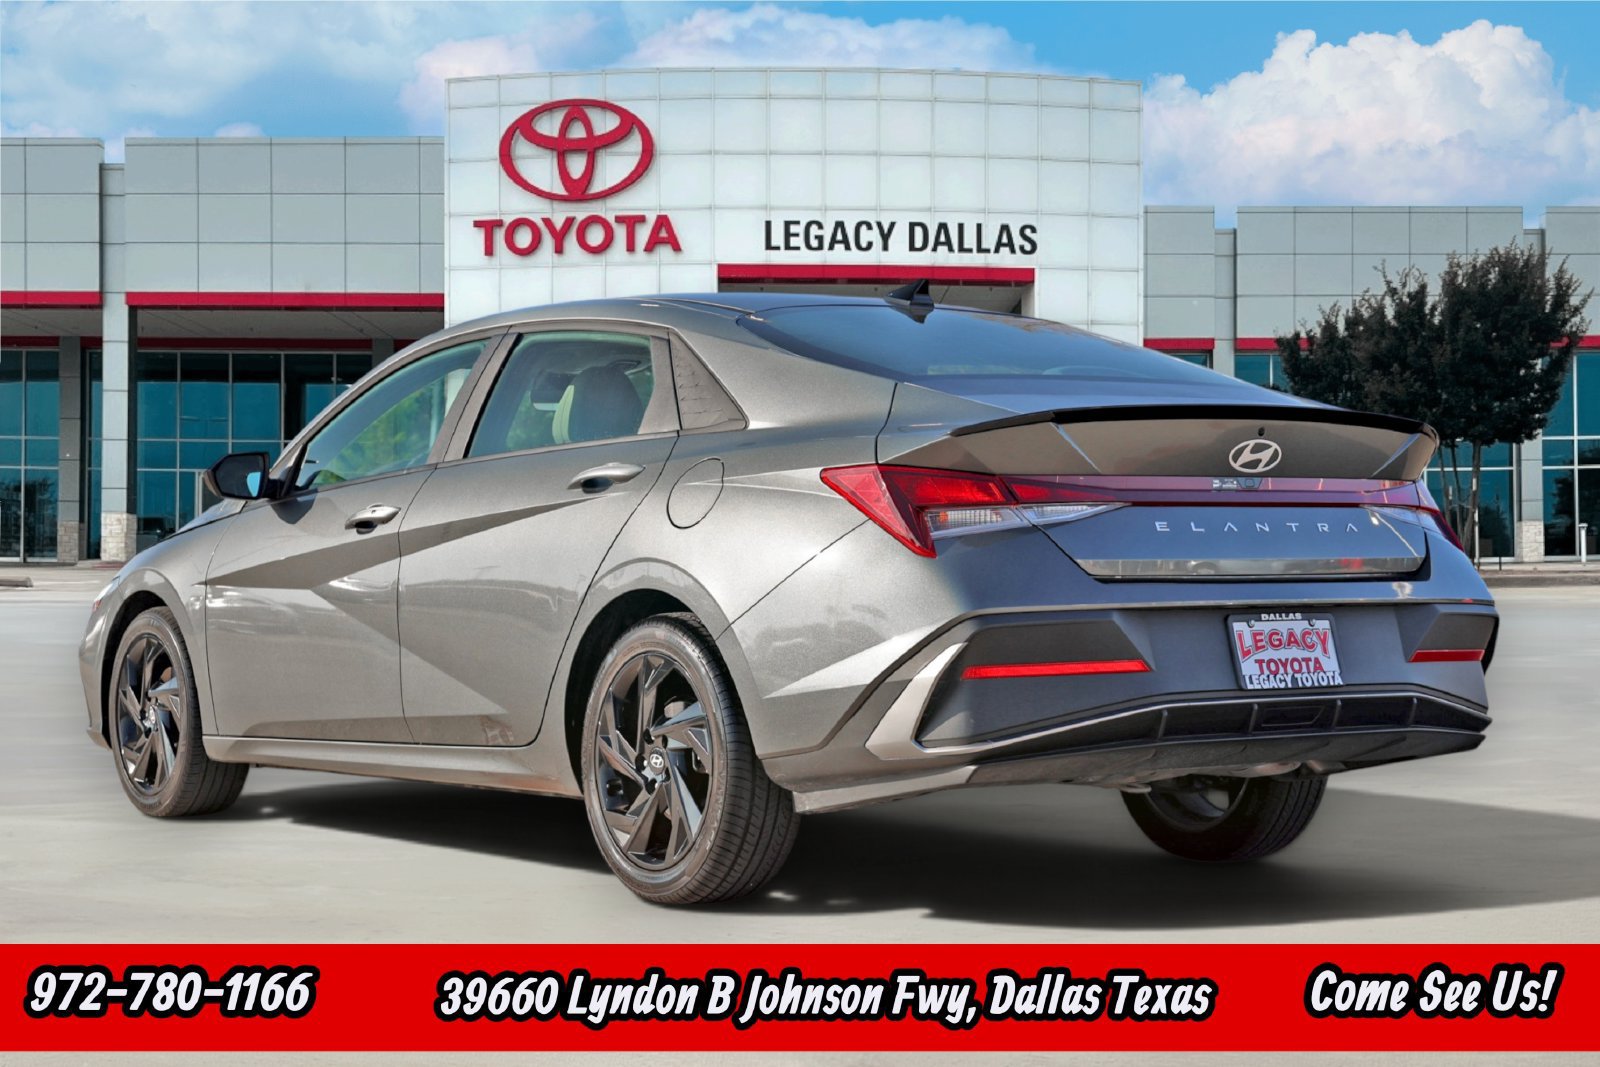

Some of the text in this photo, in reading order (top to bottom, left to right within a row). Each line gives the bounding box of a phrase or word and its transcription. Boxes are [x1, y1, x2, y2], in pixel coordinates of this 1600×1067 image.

[474, 214, 681, 257] TOYOTA
[764, 219, 1038, 255] LEGACY DALLAS
[1154, 521, 1359, 533] ELANTRA
[1261, 613, 1302, 621] DALLAS
[1236, 629, 1330, 663] LEGACY
[1255, 657, 1324, 675] TOYOTA
[1245, 671, 1343, 690] LEGACY TOYOTA
